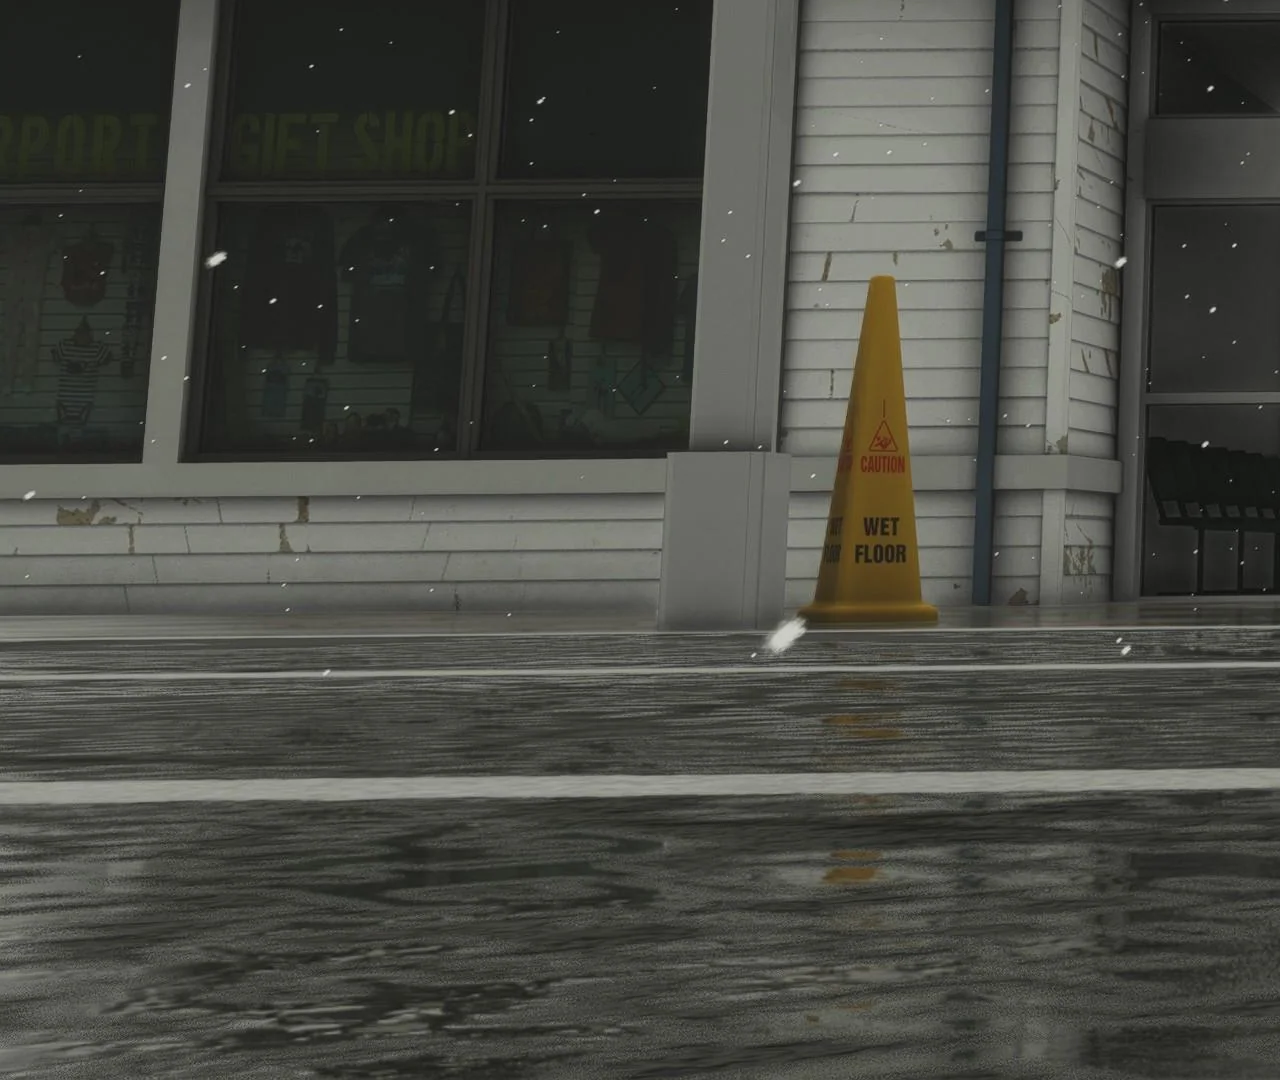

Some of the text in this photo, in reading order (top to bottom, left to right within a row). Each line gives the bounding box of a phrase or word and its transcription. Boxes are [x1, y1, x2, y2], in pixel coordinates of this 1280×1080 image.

[233, 112, 339, 174] GIFT
[353, 109, 476, 172] SHOP
[860, 454, 905, 473] CAUTION
[863, 516, 900, 536] WET
[854, 544, 907, 564] FLOOR
